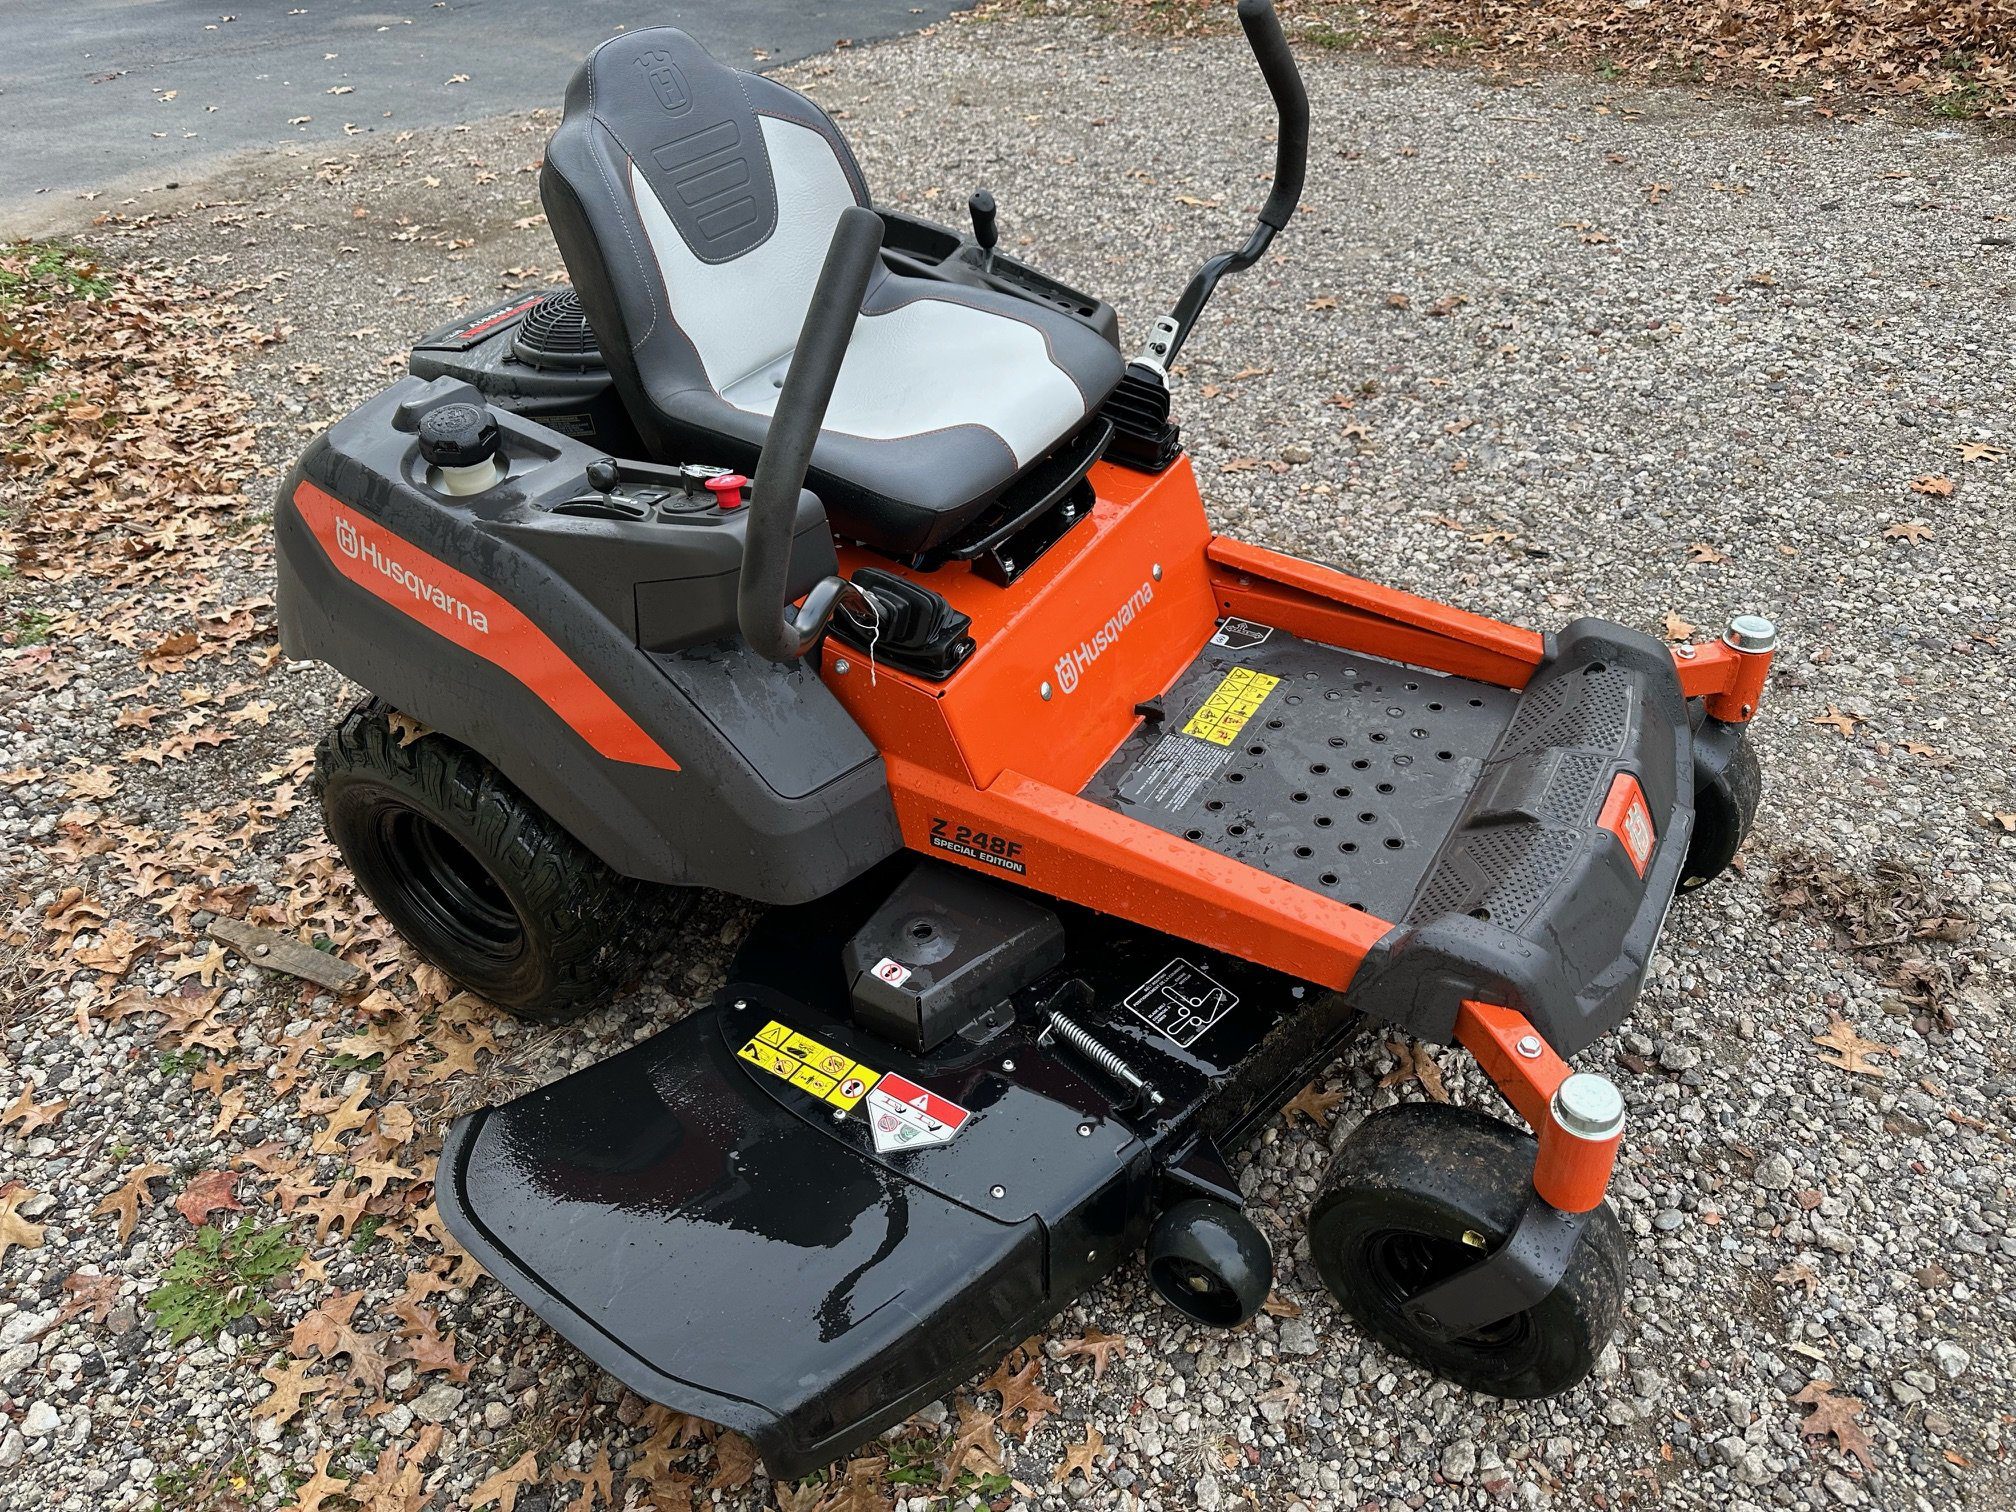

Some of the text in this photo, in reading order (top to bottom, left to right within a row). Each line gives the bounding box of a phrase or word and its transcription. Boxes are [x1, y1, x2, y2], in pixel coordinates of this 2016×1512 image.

[360, 535, 489, 635] Husqvarna
[1073, 581, 1154, 675] Husqvarna
[931, 817, 1023, 859] Z 248F
[933, 837, 1023, 873] SPECIAL EDITION
